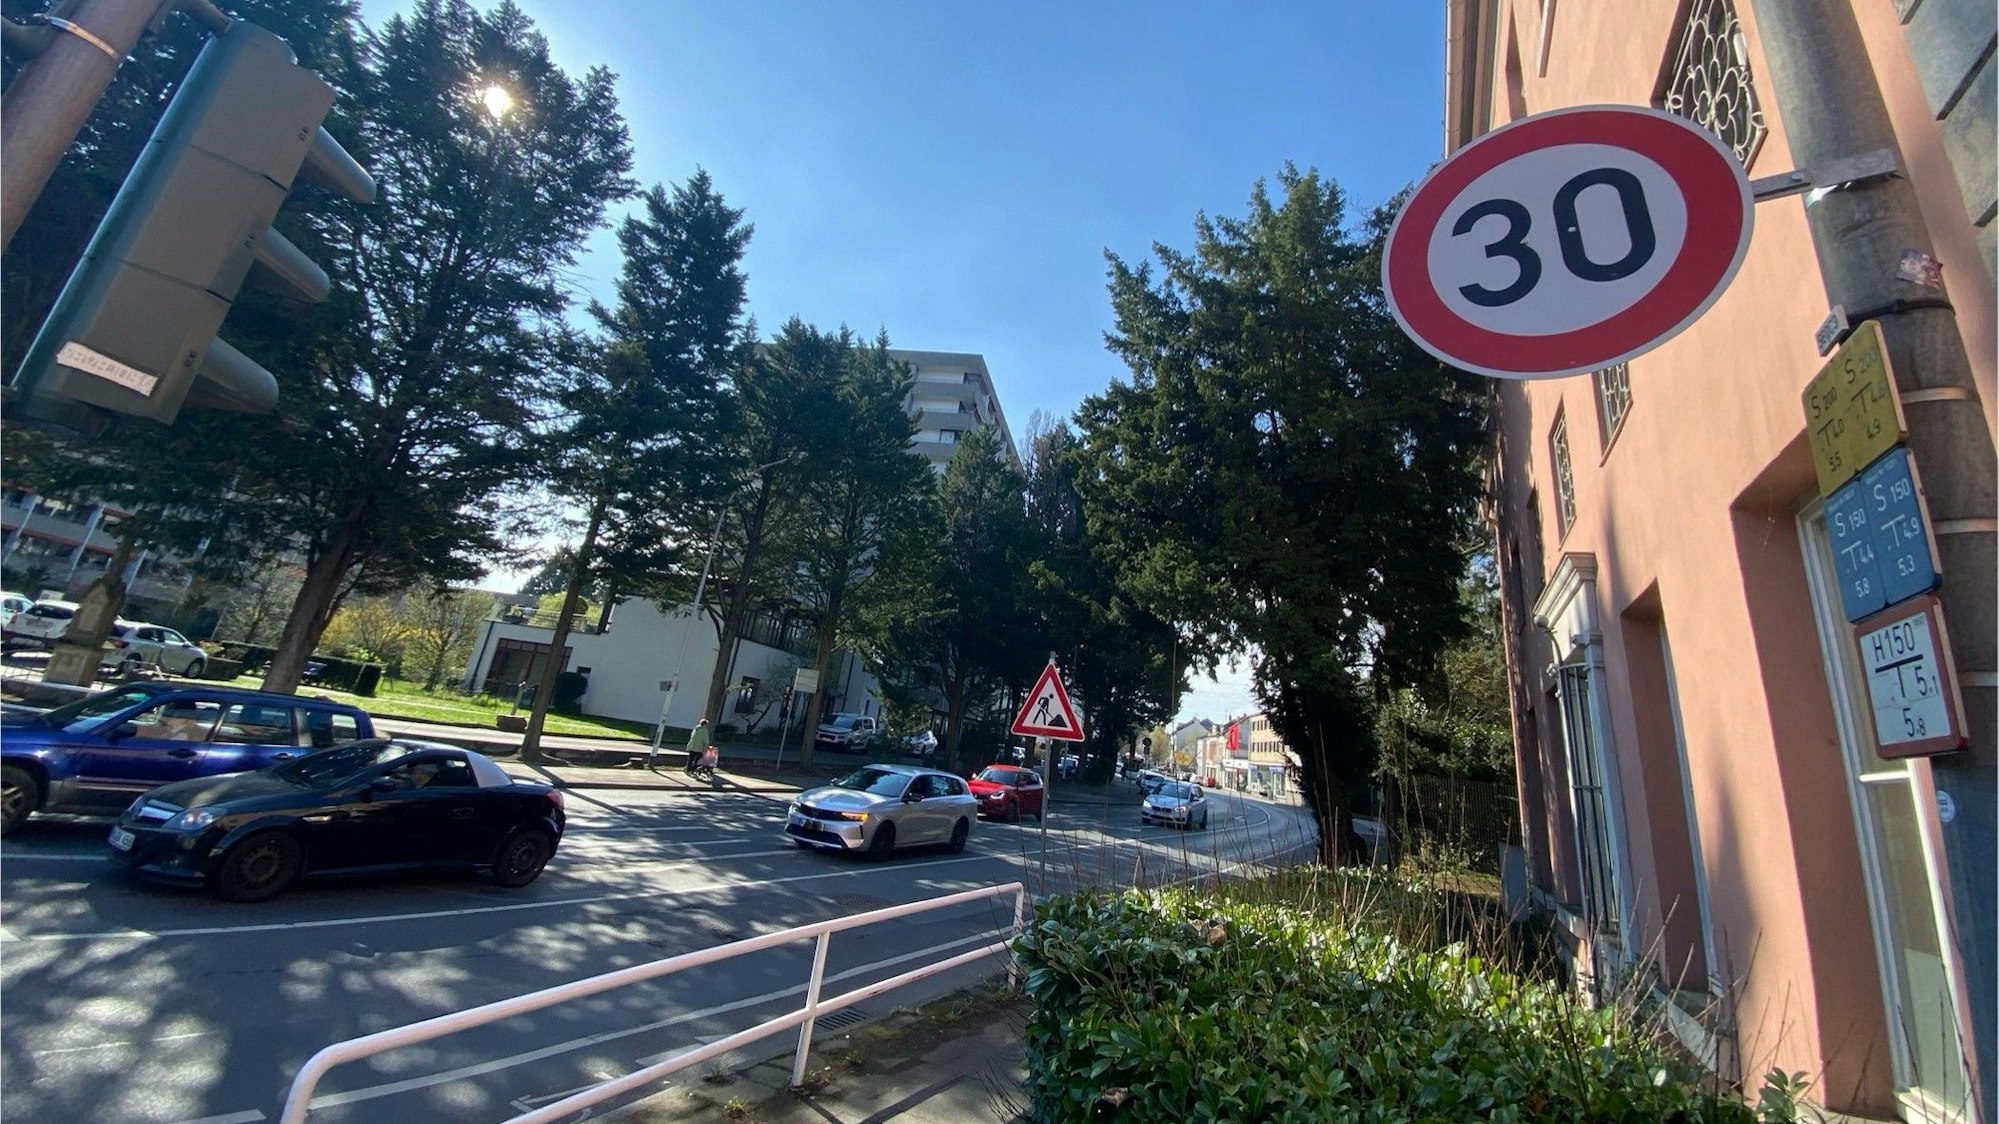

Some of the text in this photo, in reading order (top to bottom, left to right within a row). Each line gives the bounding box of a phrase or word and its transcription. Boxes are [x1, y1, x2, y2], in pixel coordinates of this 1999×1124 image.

[1451, 167, 1656, 307] 30
[1843, 358, 1856, 384] S
[1811, 386, 1838, 419] S 200
[1873, 483, 1887, 511] S
[1890, 478, 1910, 503] 150
[1834, 508, 1867, 537] S 150
[1915, 666, 1939, 697] 5.1
[1903, 708, 1927, 737] 5.8
